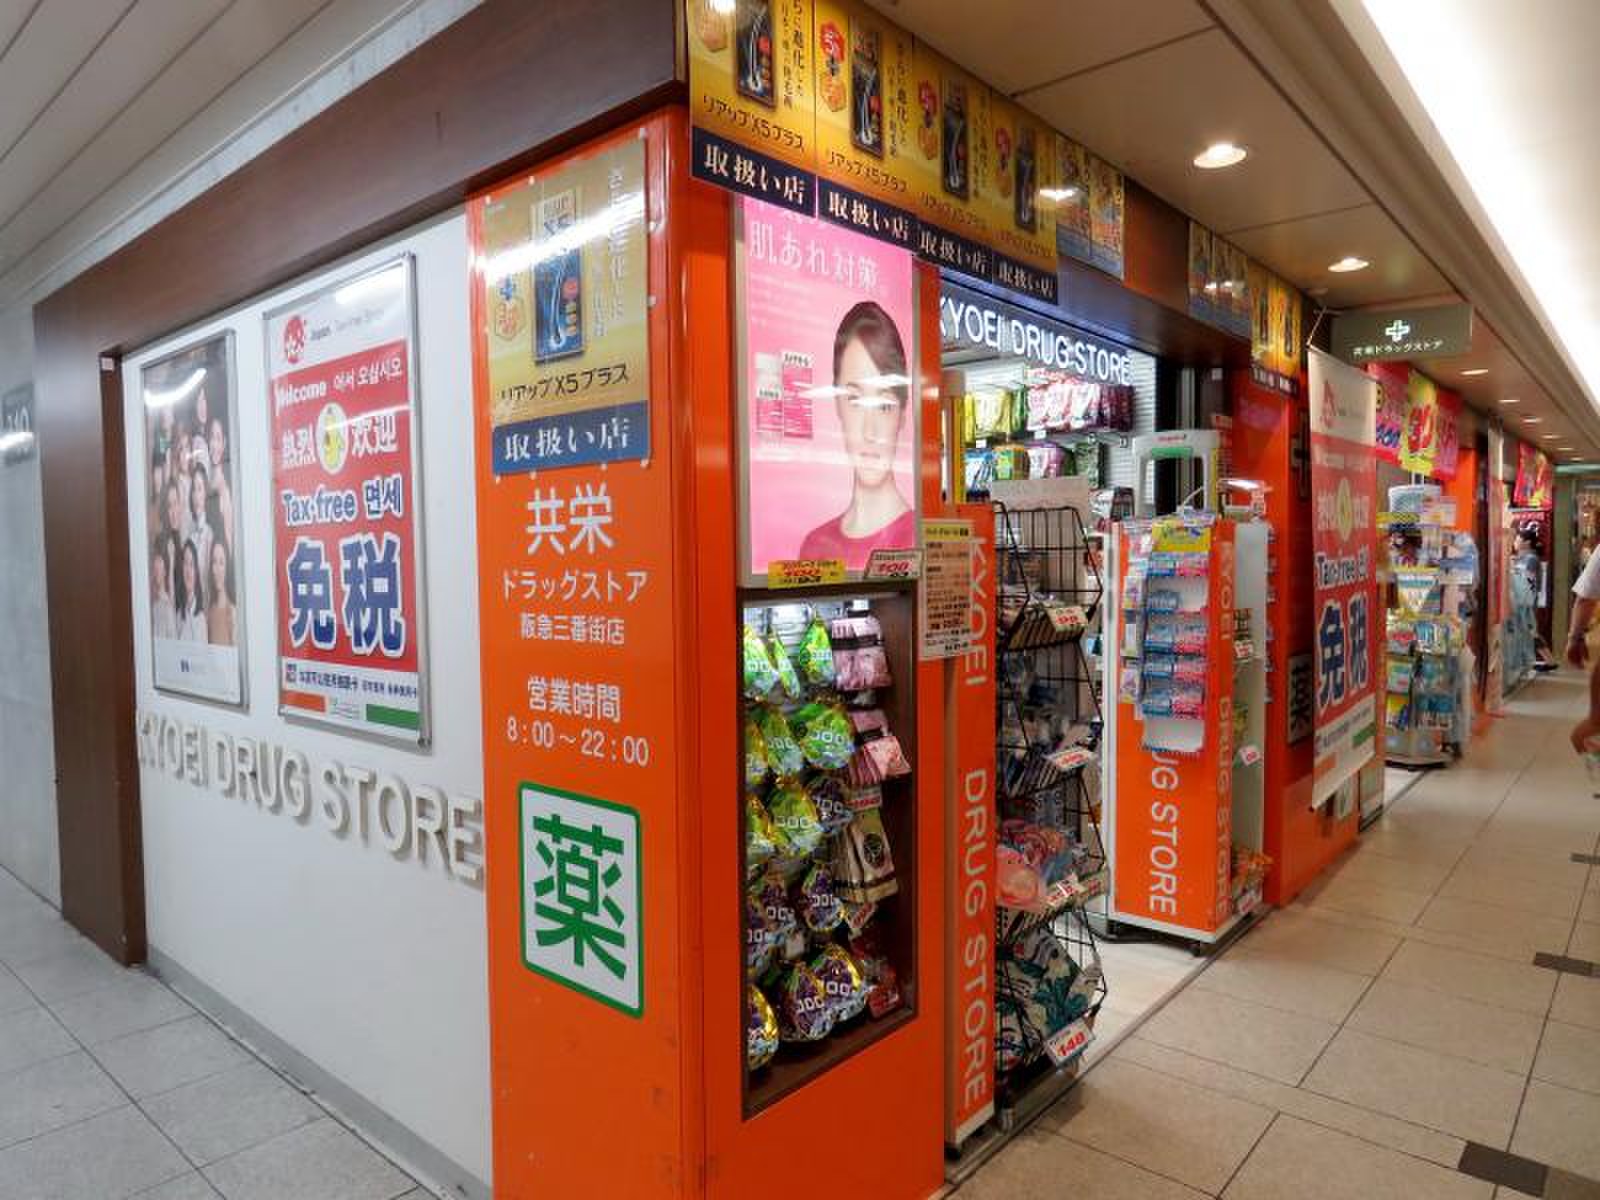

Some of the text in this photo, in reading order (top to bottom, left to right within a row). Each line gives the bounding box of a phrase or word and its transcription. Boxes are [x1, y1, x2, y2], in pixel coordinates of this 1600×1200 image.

[704, 143, 806, 206] 取扱い店
[828, 191, 909, 243] 取扱い店
[501, 362, 629, 401] リアップX5プラス
[1010, 319, 1069, 369] DRUG
[1074, 341, 1131, 386] STORE
[505, 418, 630, 463] 取扱い店
[526, 482, 615, 555] 共栄
[286, 532, 407, 659] 免税
[502, 568, 649, 603] ドラッグストア
[520, 612, 626, 647] 阪急三番街店
[526, 676, 622, 724] 営業時間
[212, 732, 314, 826] DRUG
[319, 757, 486, 884] STORE
[963, 769, 989, 918] DRUG
[1150, 801, 1180, 917] STORE
[532, 812, 627, 982] 薬
[963, 933, 989, 1109] STORE
